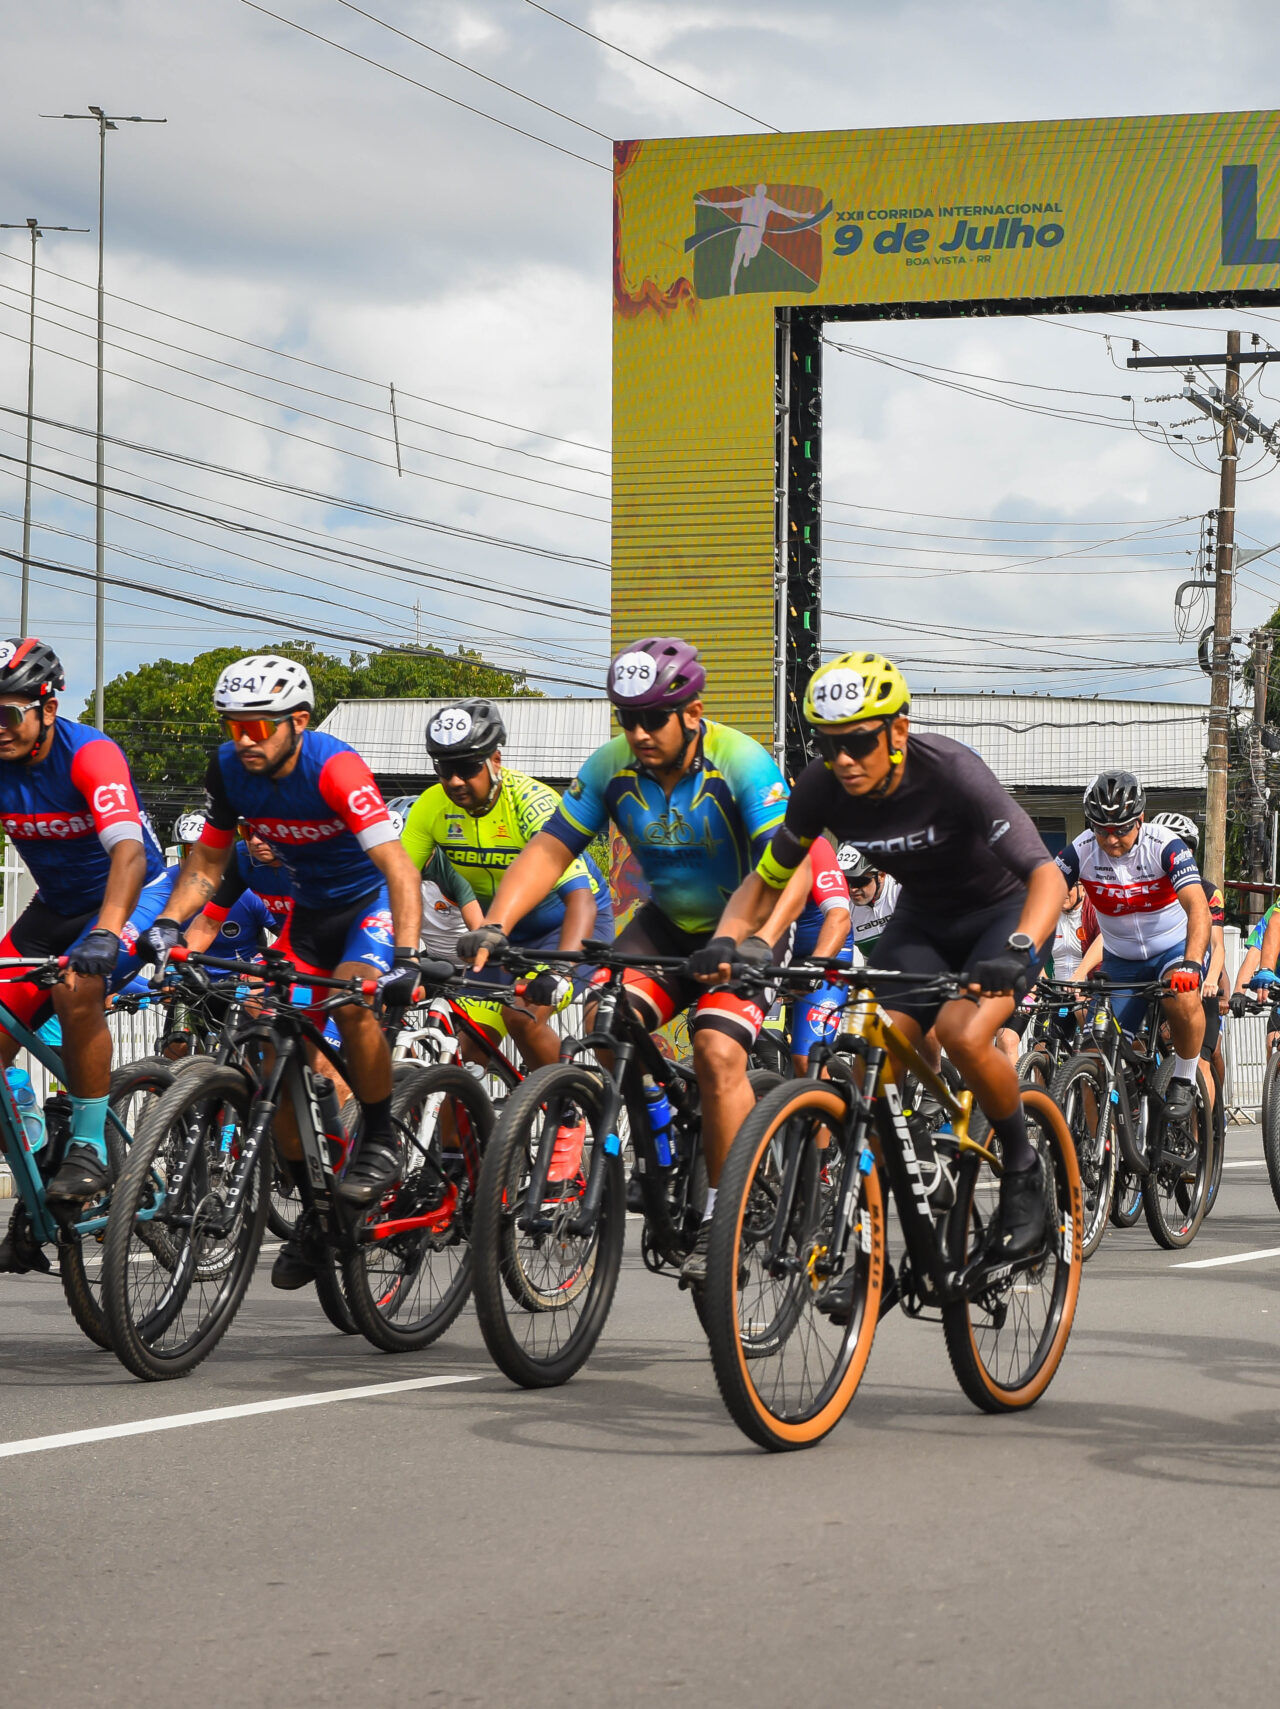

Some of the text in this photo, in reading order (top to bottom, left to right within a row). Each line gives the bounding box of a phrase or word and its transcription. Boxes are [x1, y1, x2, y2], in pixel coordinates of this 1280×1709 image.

[836, 202, 1063, 222] XXII CORRIDA INTERNACIONAL
[832, 217, 1065, 256] 9 de Julho
[905, 257, 930, 267] BOA
[933, 255, 967, 265] VISTA
[976, 254, 991, 264] RR
[615, 664, 650, 681] 298
[816, 682, 859, 702] 408
[433, 718, 467, 732] 336
[837, 852, 859, 863] 322
[1092, 882, 1161, 899] TREK
